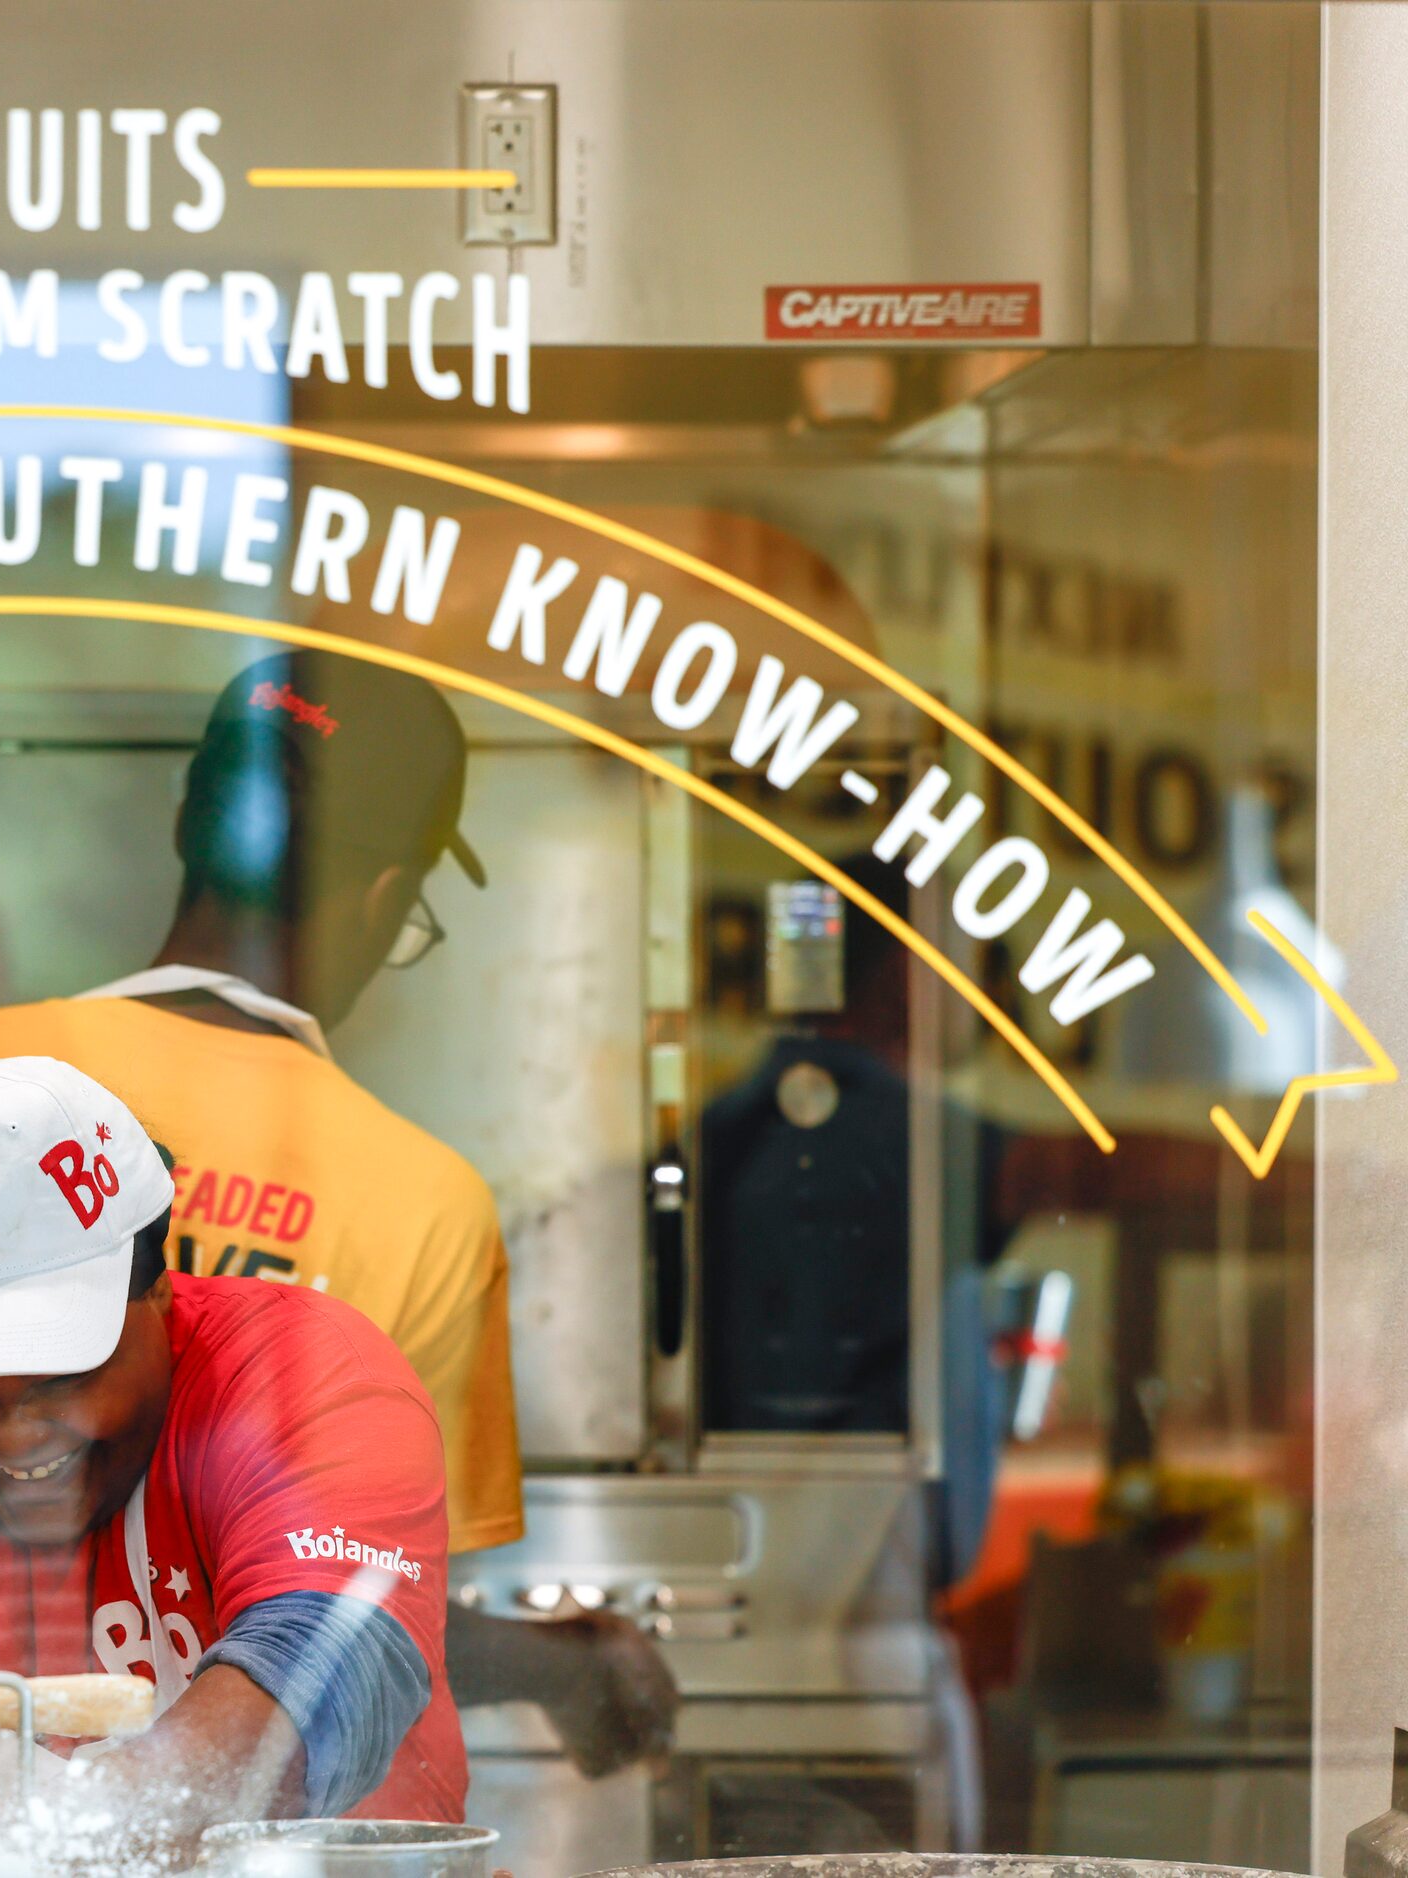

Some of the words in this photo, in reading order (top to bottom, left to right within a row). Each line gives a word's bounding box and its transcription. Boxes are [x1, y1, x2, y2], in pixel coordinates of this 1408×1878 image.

[96, 269, 532, 414] SCRATCH
[487, 543, 1155, 1027] KNOW-HOW
[38, 1140, 120, 1230] Bo
[170, 1165, 315, 1243] EADED
